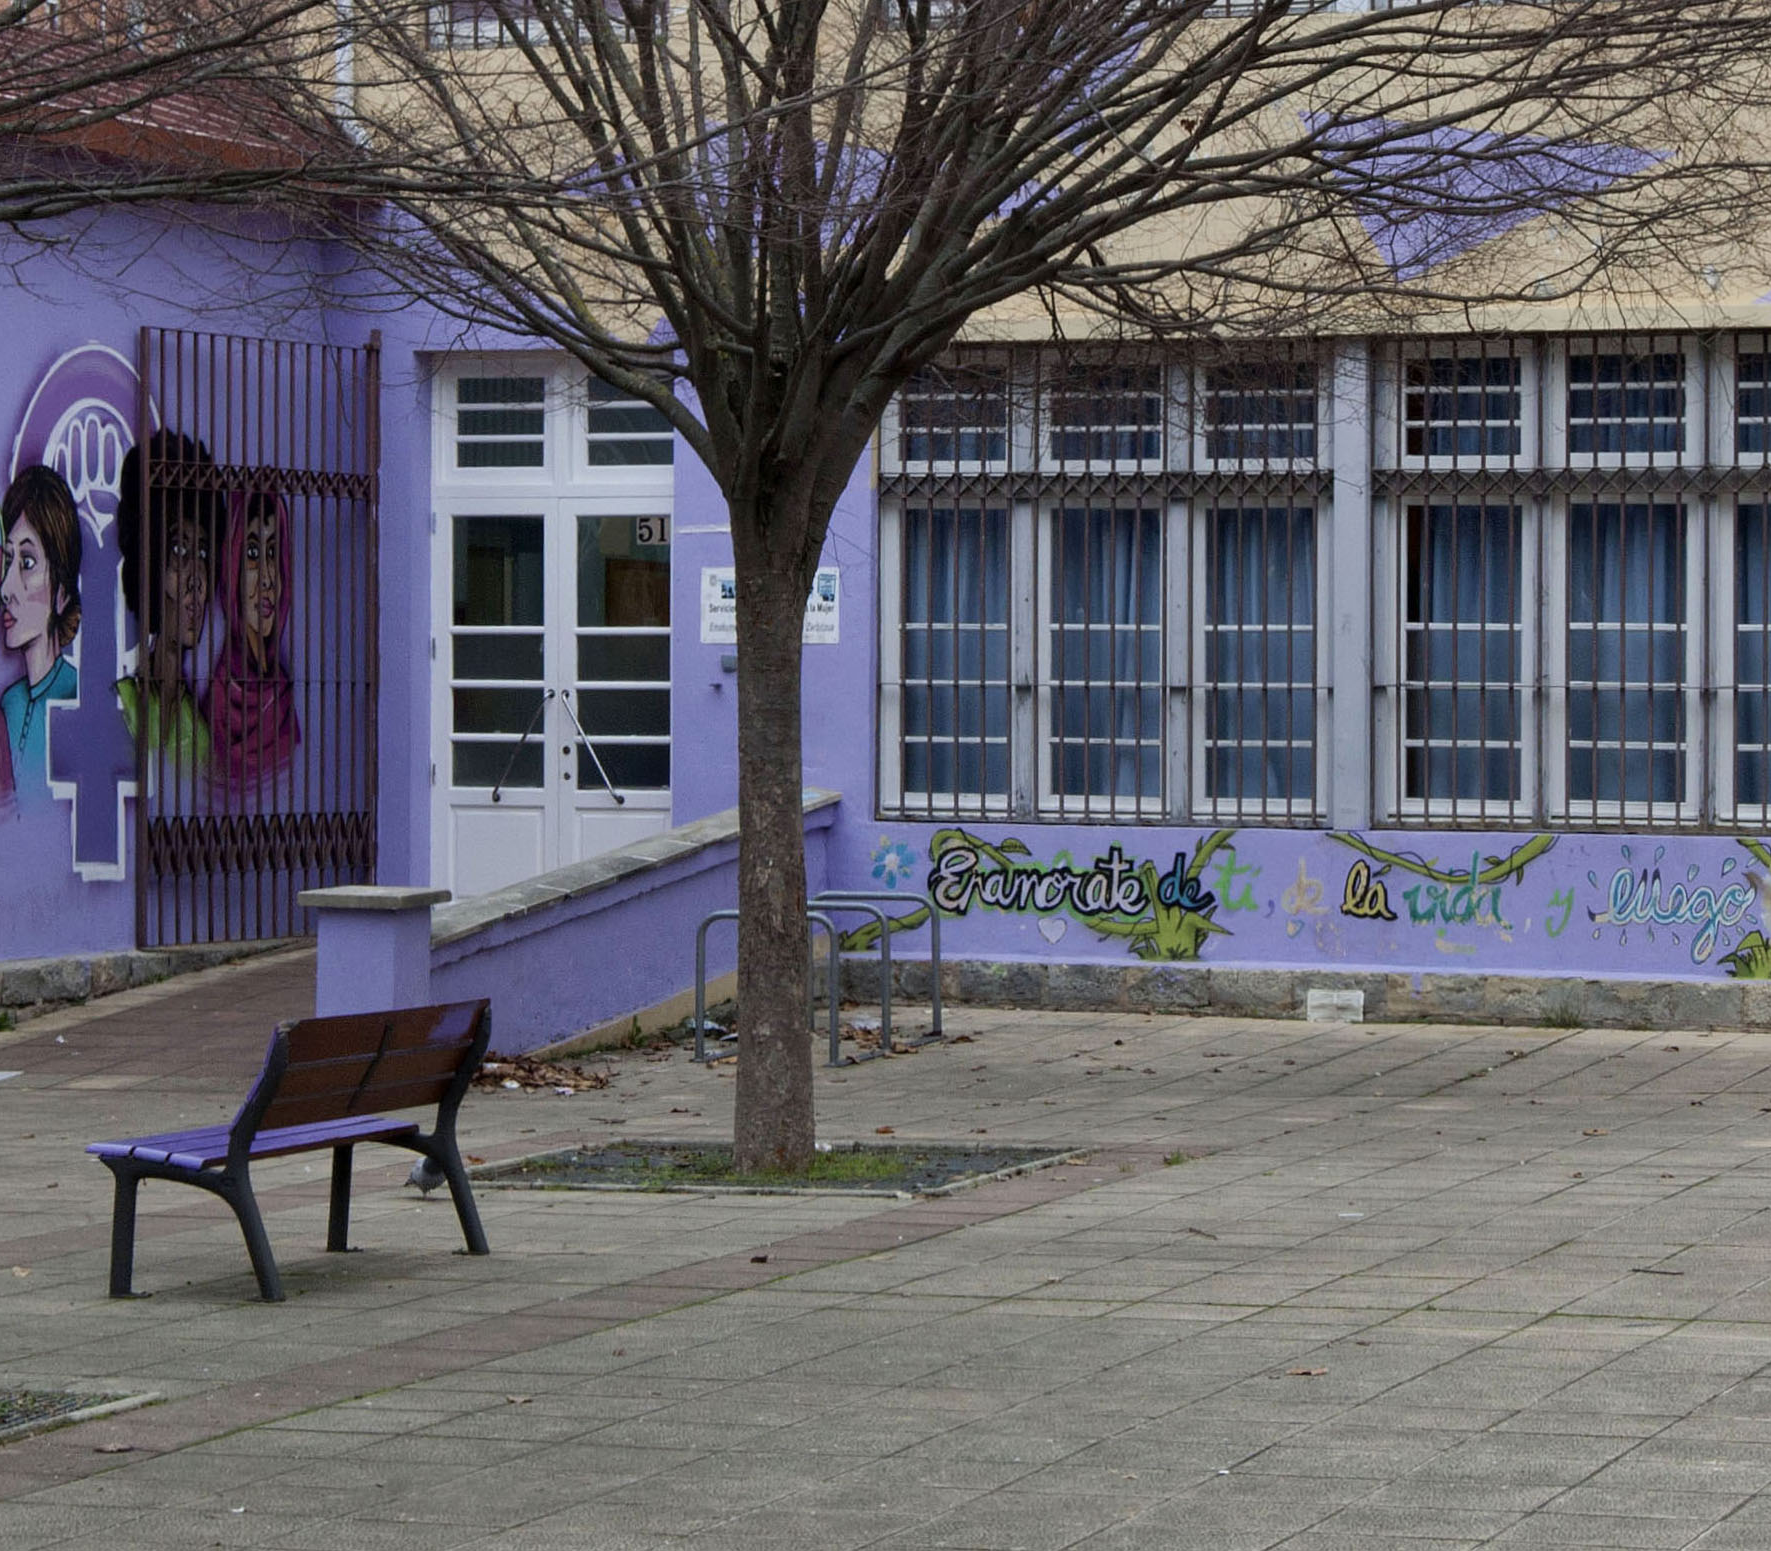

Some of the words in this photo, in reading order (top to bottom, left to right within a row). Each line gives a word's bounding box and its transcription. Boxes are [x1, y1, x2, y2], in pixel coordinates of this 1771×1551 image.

[638, 518, 667, 543] 51
[817, 604, 834, 615] Mujer
[1159, 852, 1215, 911] de
[1282, 856, 1328, 916] de
[1340, 859, 1398, 921] la
[1546, 887, 1575, 937] y
